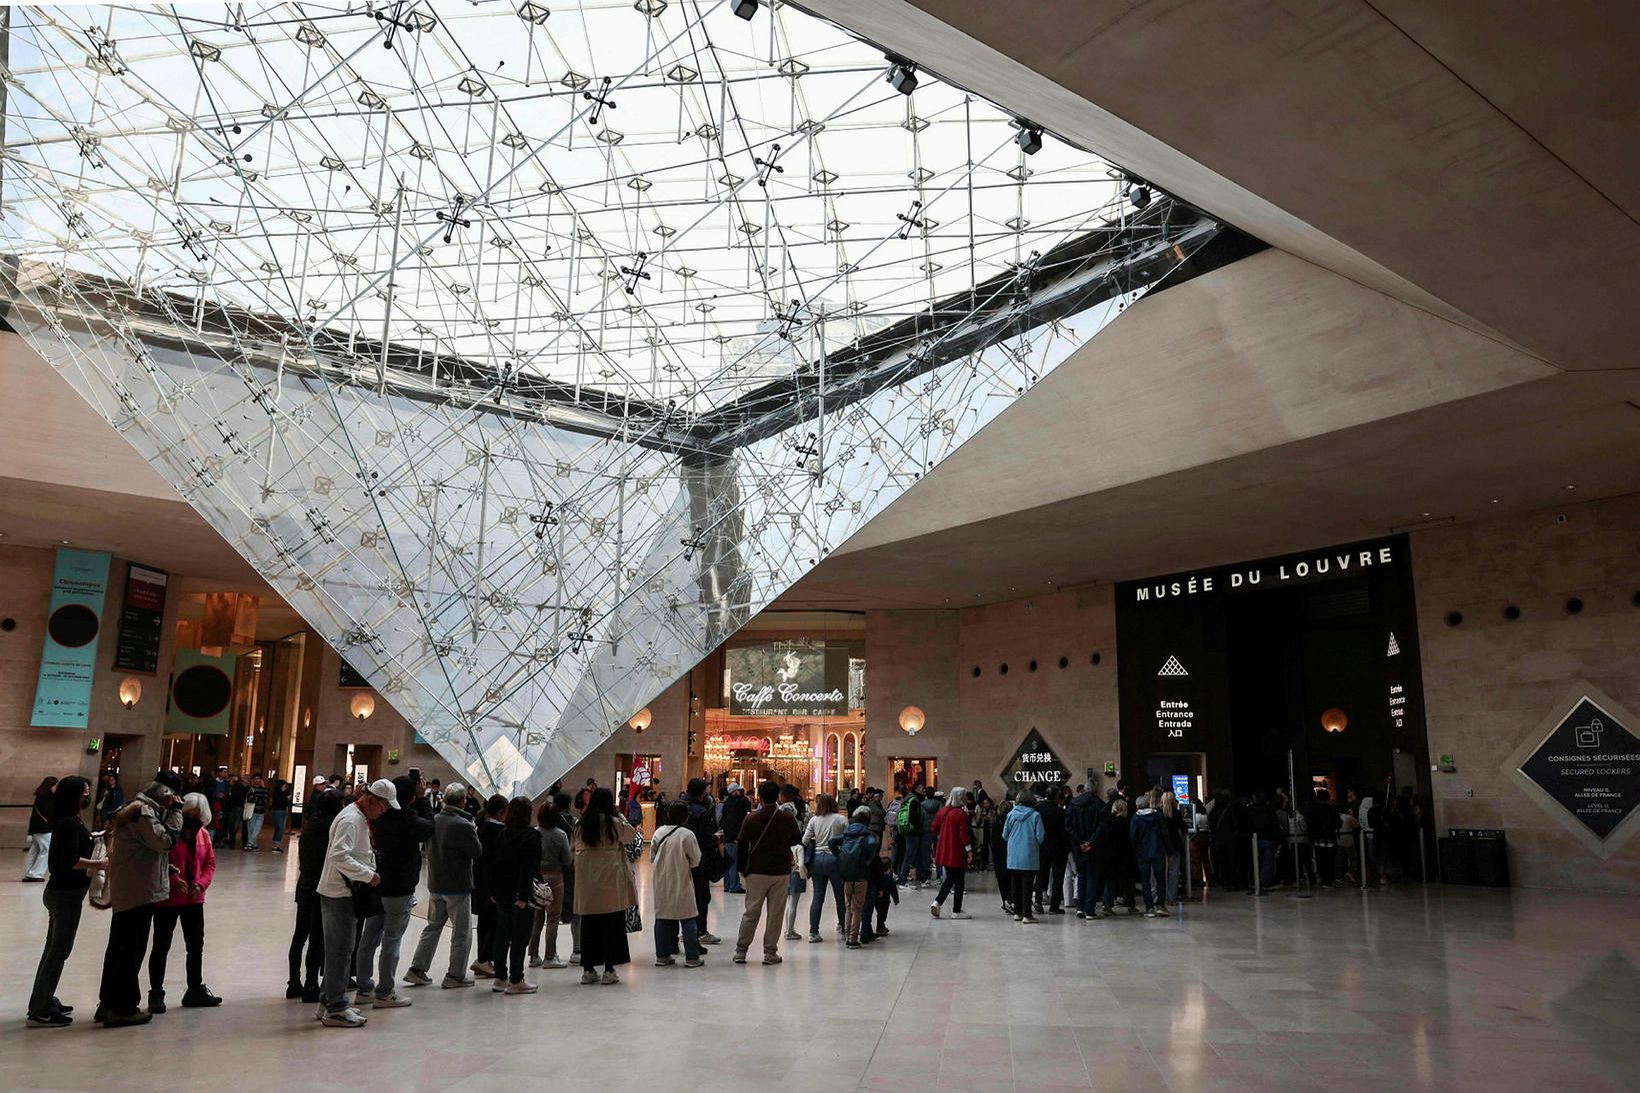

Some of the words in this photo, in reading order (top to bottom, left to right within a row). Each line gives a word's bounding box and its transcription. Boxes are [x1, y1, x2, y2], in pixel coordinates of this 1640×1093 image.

[1136, 576, 1214, 602] MUSÉE
[1231, 570, 1262, 588] DU
[1280, 547, 1392, 580] LOUVRE
[778, 683, 844, 704] Concerto
[1160, 700, 1189, 709] Entrée
[1156, 710, 1194, 718] Entrance
[1158, 719, 1192, 728] Entrada
[1167, 729, 1183, 738] 入口
[1021, 752, 1052, 763] 货币兑换
[1548, 754, 1591, 762] CONSIGNES
[1014, 770, 1061, 782] CHANGE
[1560, 768, 1595, 776] SECURED
[1596, 767, 1632, 776] LOCKERS
